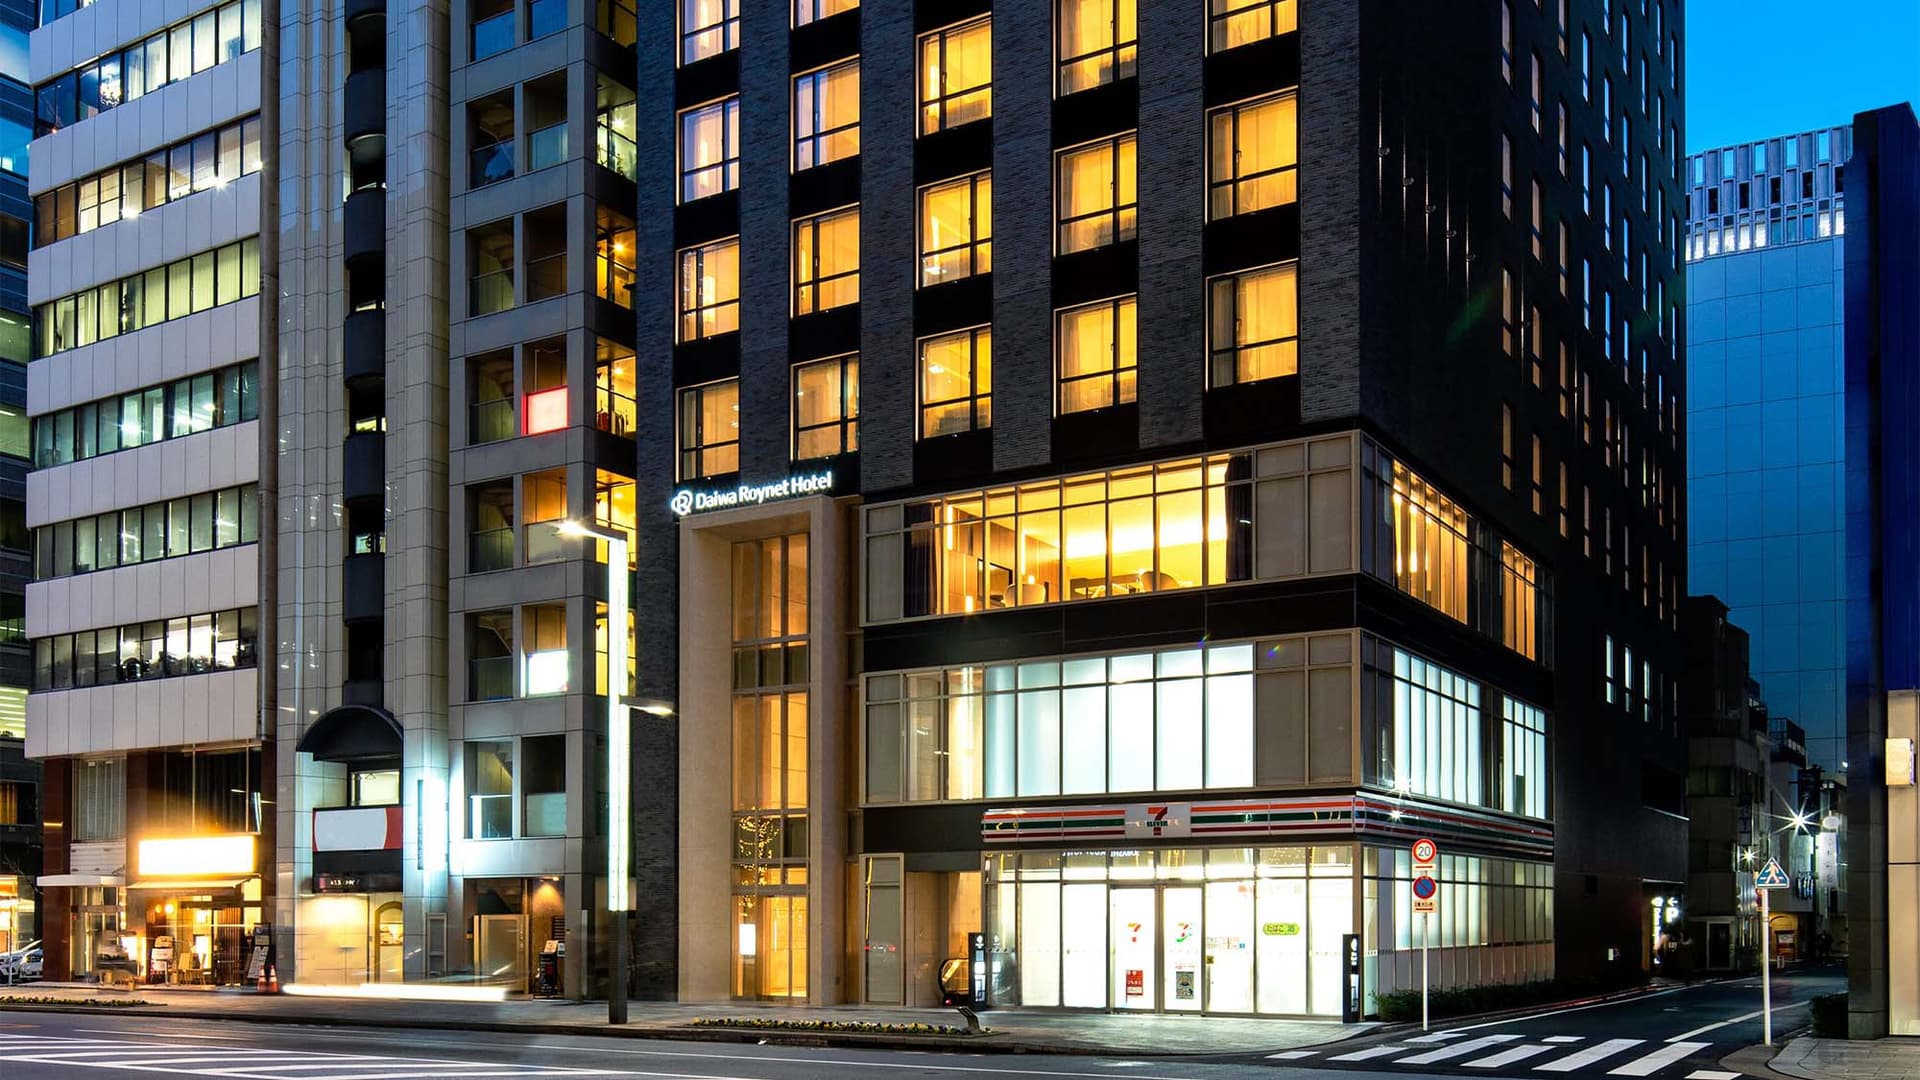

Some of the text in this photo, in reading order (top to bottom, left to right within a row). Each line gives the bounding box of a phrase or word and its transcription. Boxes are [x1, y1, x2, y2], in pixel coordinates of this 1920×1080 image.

[695, 471, 832, 509] Daiwa Roynet Hotel
[1148, 807, 1168, 836] 7
[1418, 846, 1431, 857] 20
[1665, 907, 1679, 923] P
